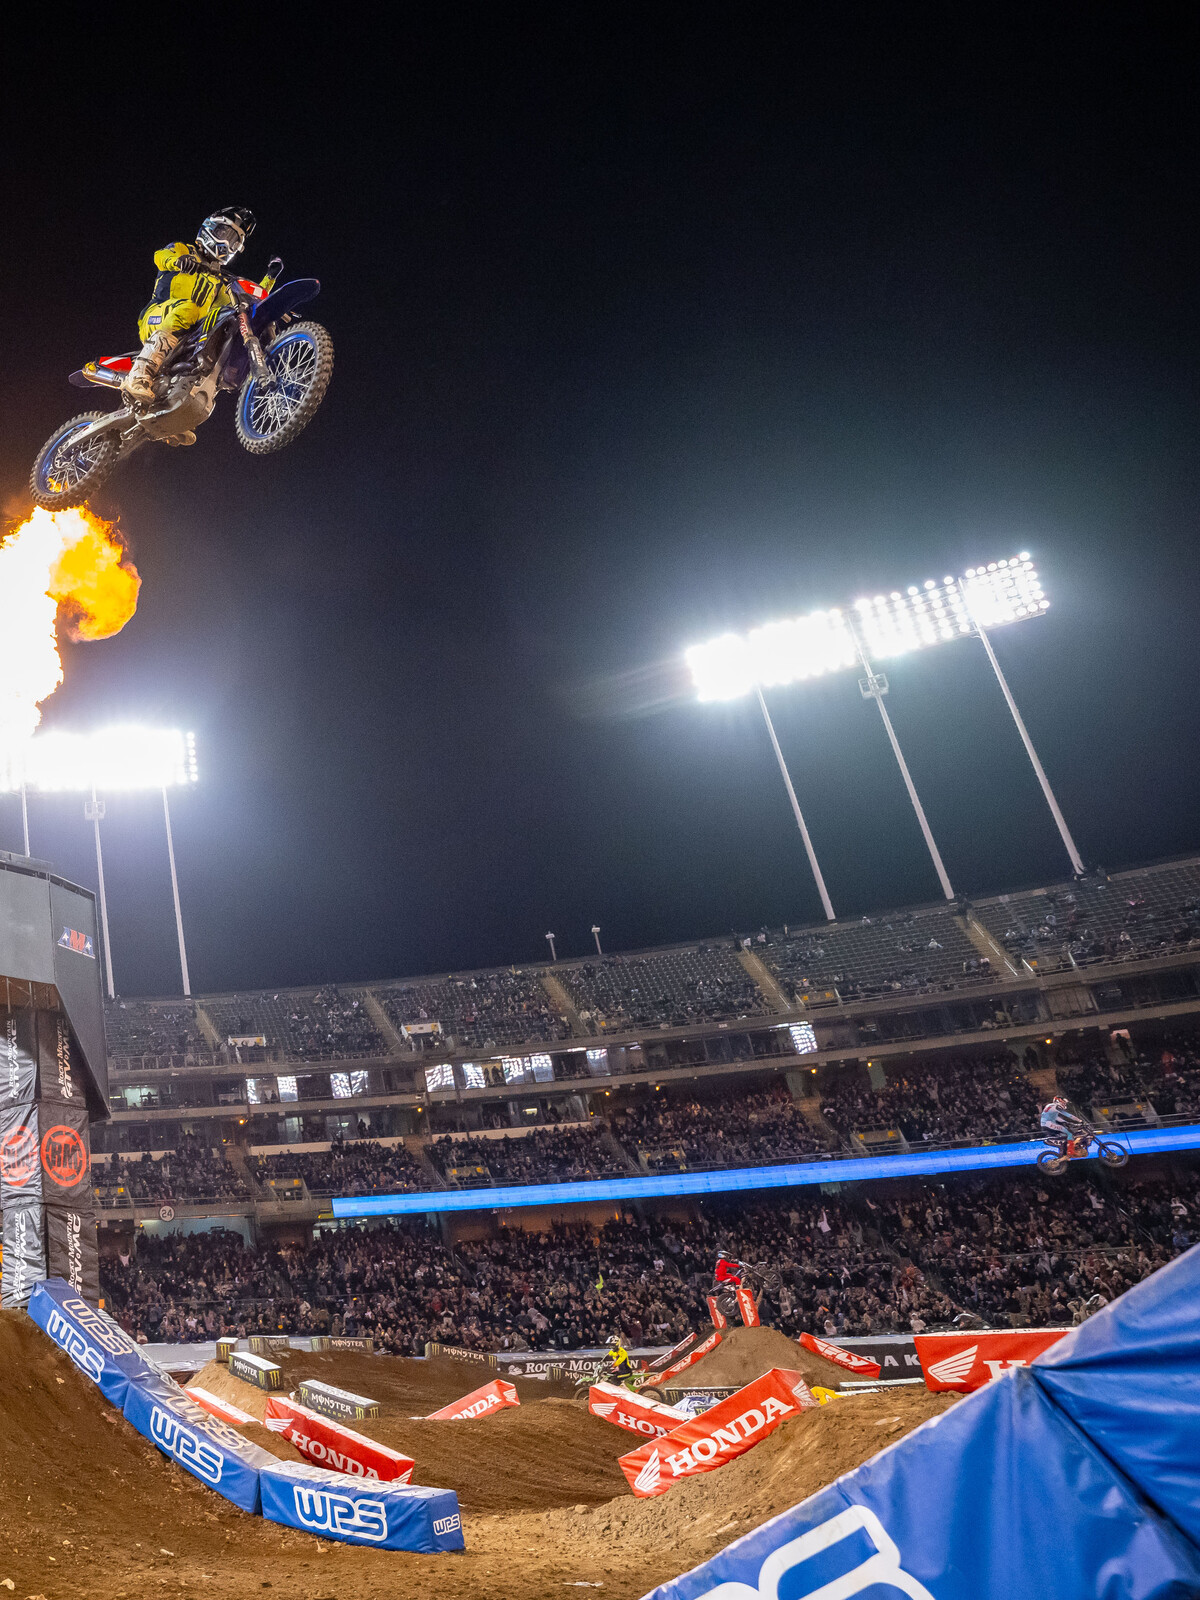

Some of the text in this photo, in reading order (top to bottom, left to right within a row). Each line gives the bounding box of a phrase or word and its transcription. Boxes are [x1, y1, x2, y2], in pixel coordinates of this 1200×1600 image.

[57, 926, 95, 956] AMA
[161, 1209, 173, 1218] 24
[66, 1212, 76, 1288] ROCKY MOUNTAIN
[46, 1309, 106, 1384] WPS
[62, 1298, 133, 1356] WPS
[813, 1338, 870, 1367] FLY
[525, 1359, 640, 1374] ROCKY MOUNTN
[150, 1405, 225, 1484] WPS
[290, 1429, 380, 1480] HONDA
[665, 1396, 795, 1477] HONDA
[293, 1485, 388, 1542] WPS
[432, 1513, 462, 1536] WPS
